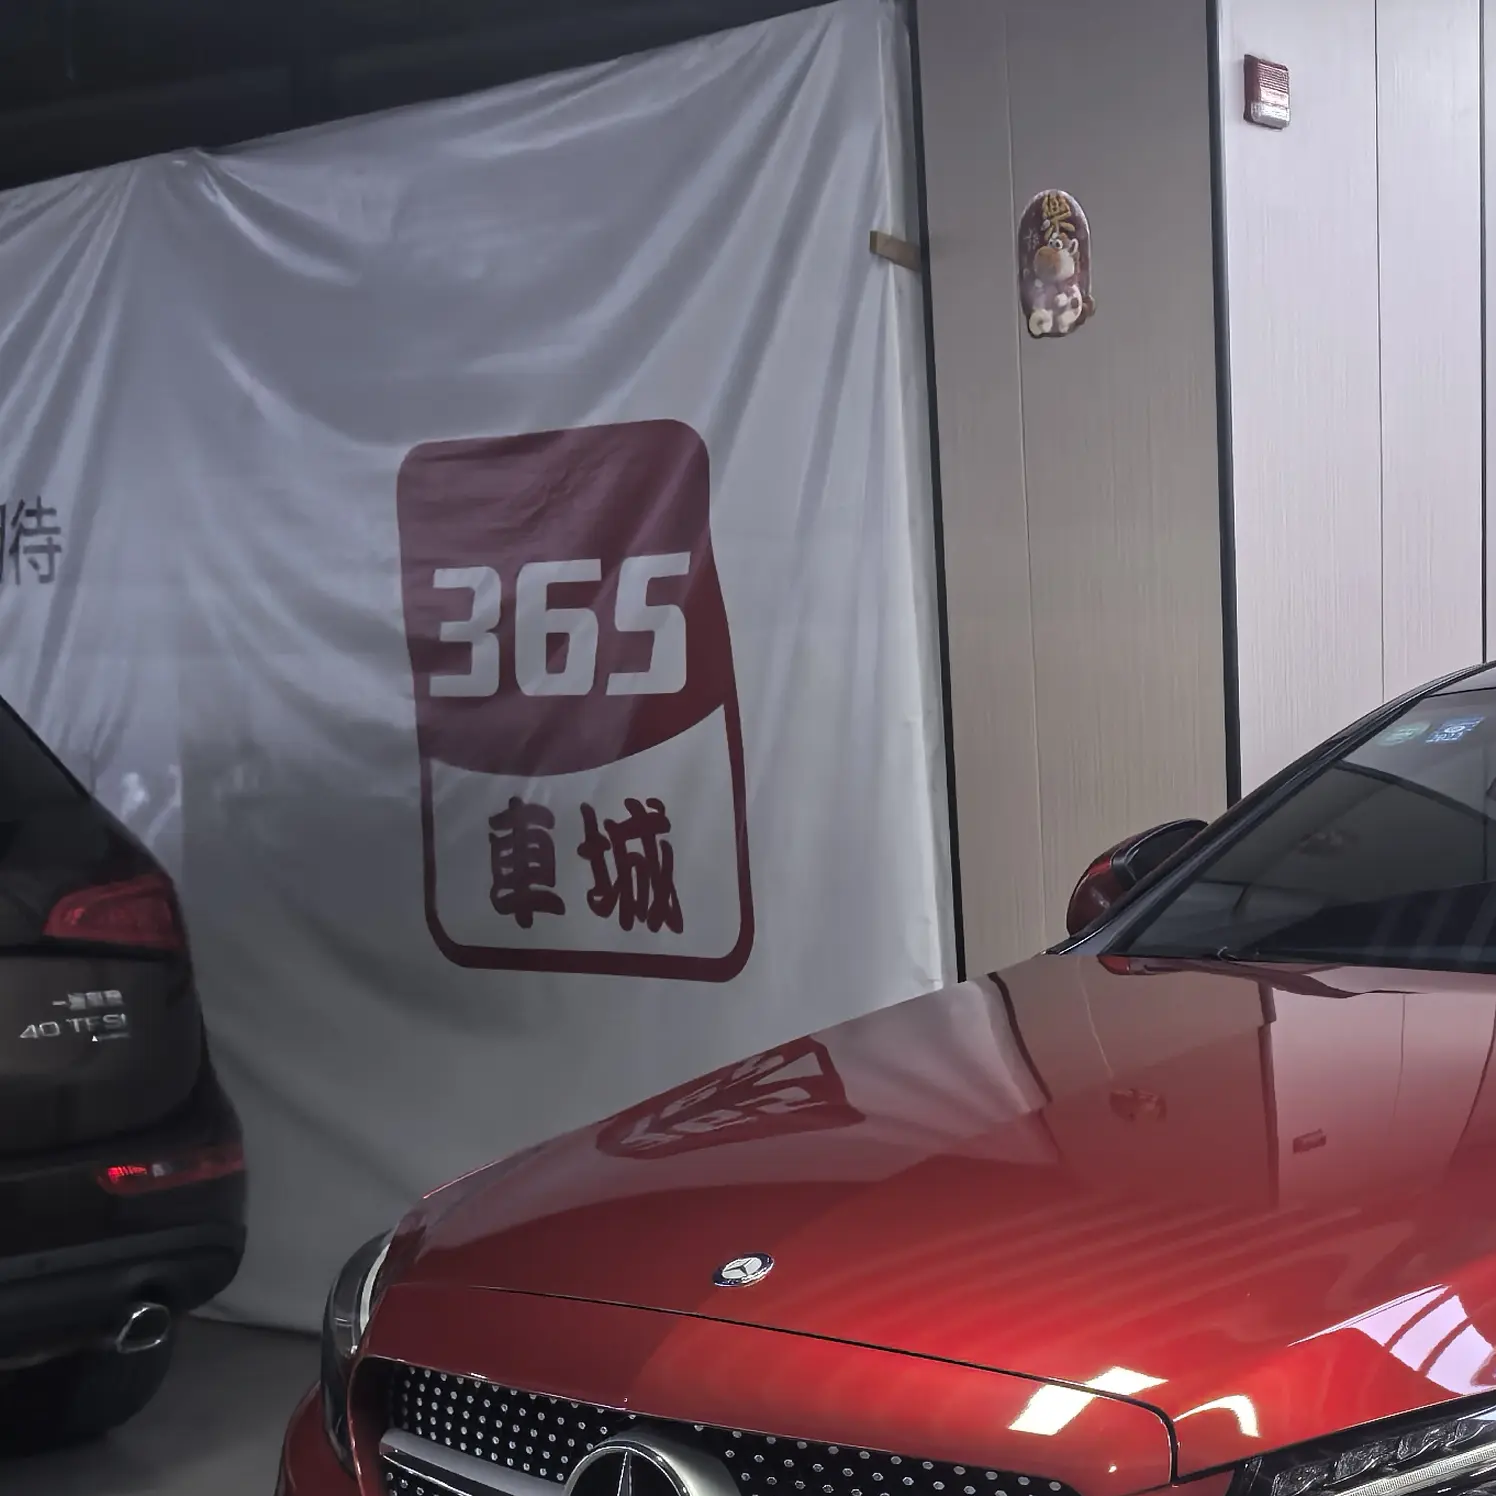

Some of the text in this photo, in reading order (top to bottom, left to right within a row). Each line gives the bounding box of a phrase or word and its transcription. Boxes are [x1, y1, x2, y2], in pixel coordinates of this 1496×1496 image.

[0, 495, 62, 587] 待
[429, 551, 691, 697] 365
[488, 796, 684, 934] 車城
[19, 1013, 128, 1039] 40 TFSI
